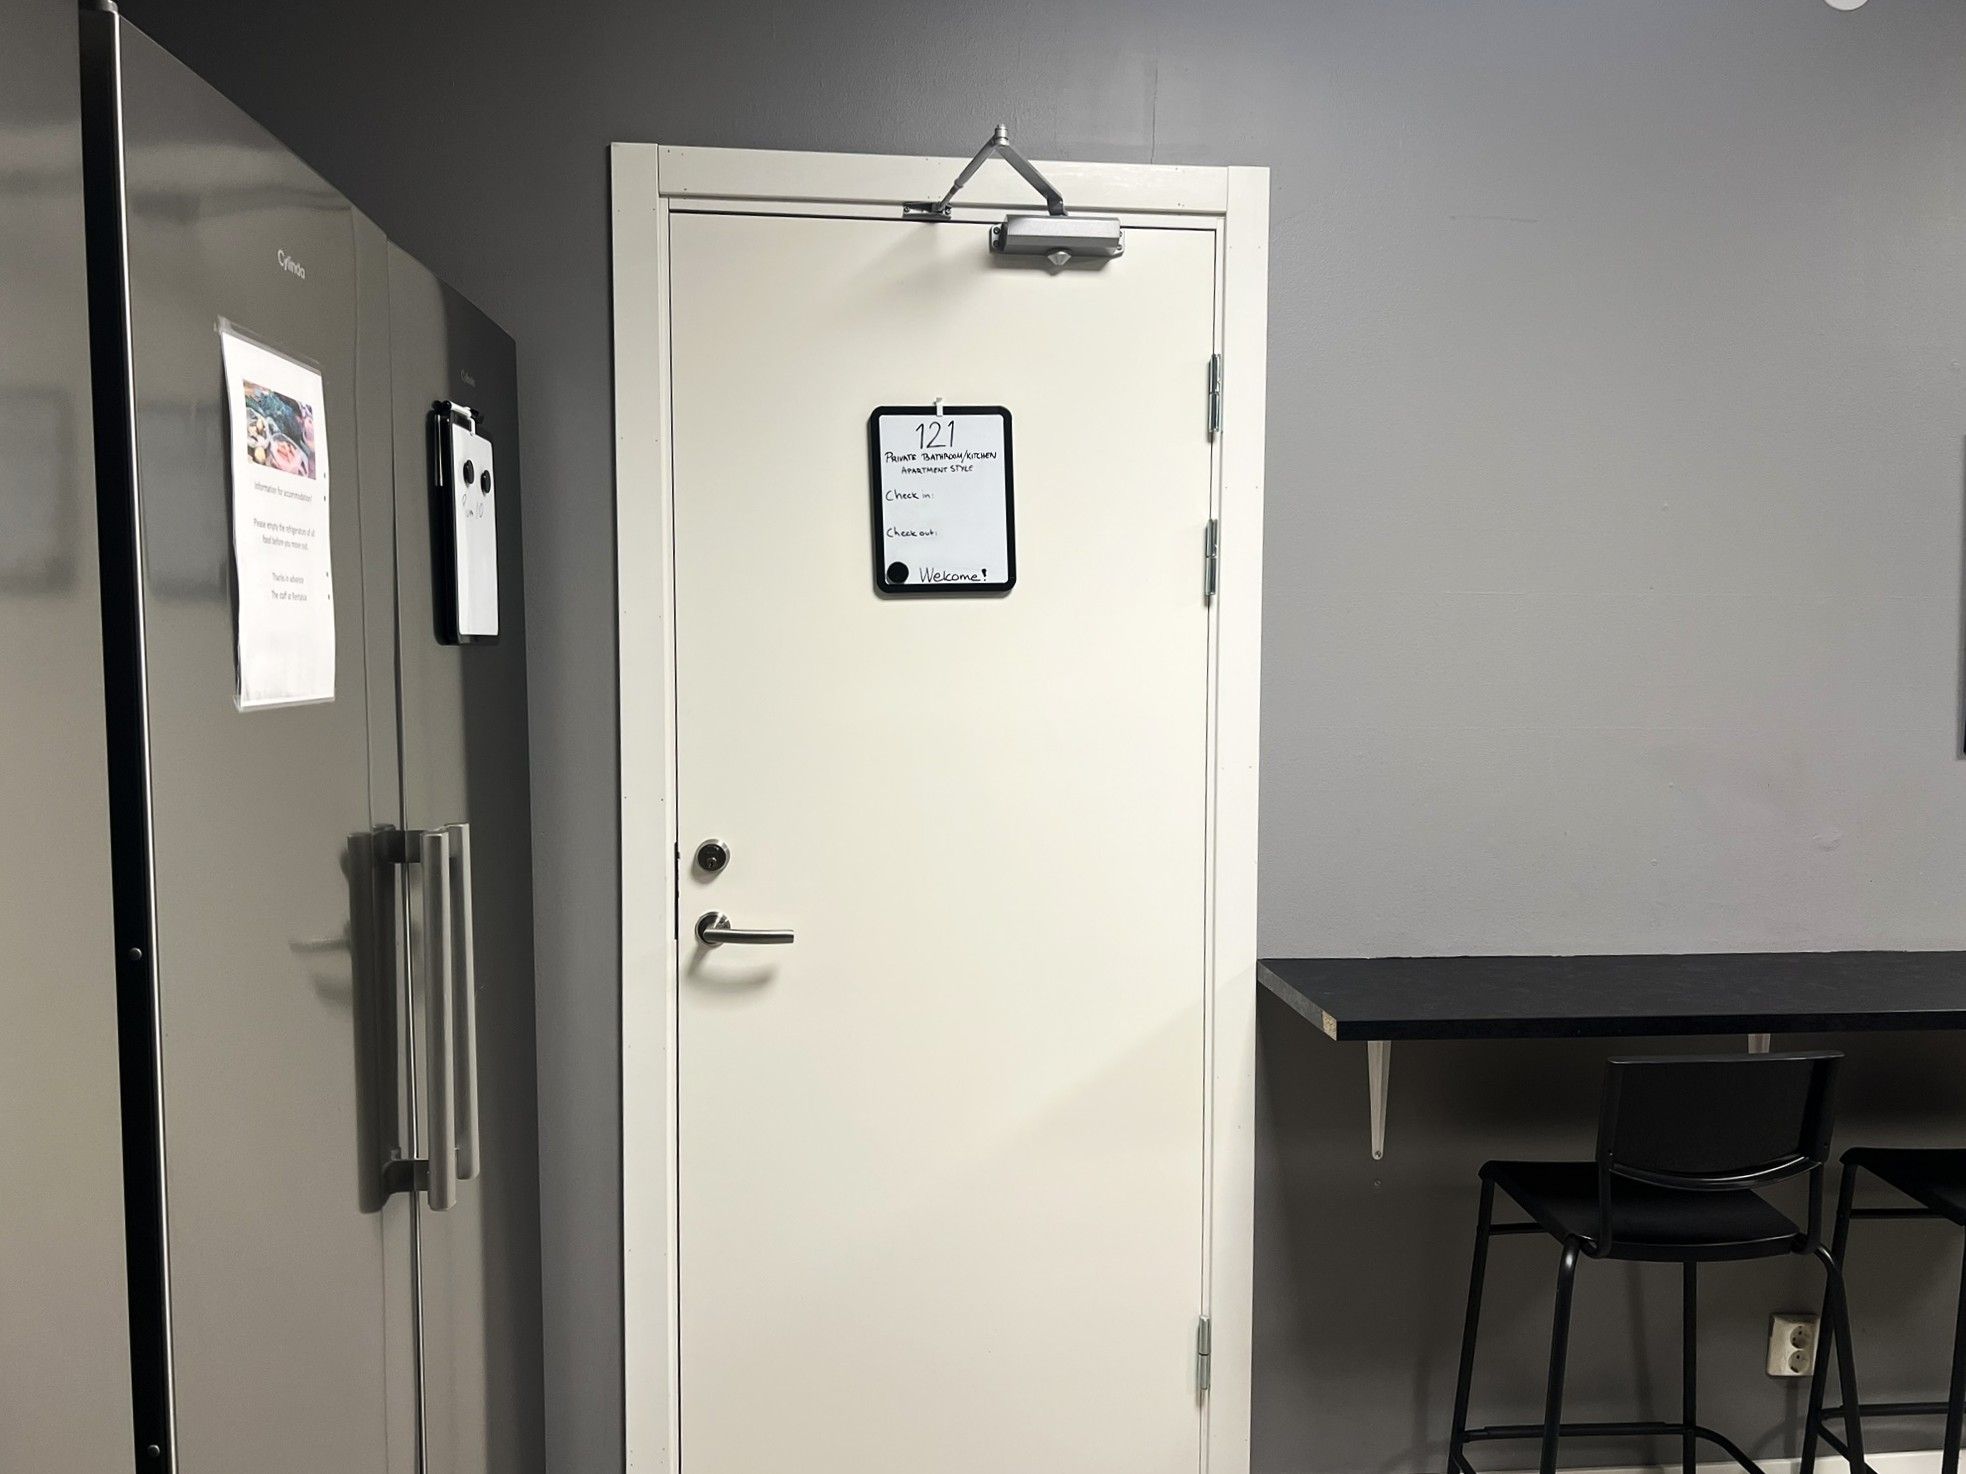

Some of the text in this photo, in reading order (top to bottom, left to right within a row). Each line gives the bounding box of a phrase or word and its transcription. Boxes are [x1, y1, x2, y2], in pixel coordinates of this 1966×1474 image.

[277, 249, 306, 279] Cylinda
[916, 420, 955, 449] 121
[885, 450, 997, 463] PRIVATE BATHROOM/KITCHEN
[901, 464, 974, 475] APARTMENT STYLE
[885, 489, 920, 501] Check
[887, 526, 918, 538] Check
[919, 567, 987, 583] Welcome!
